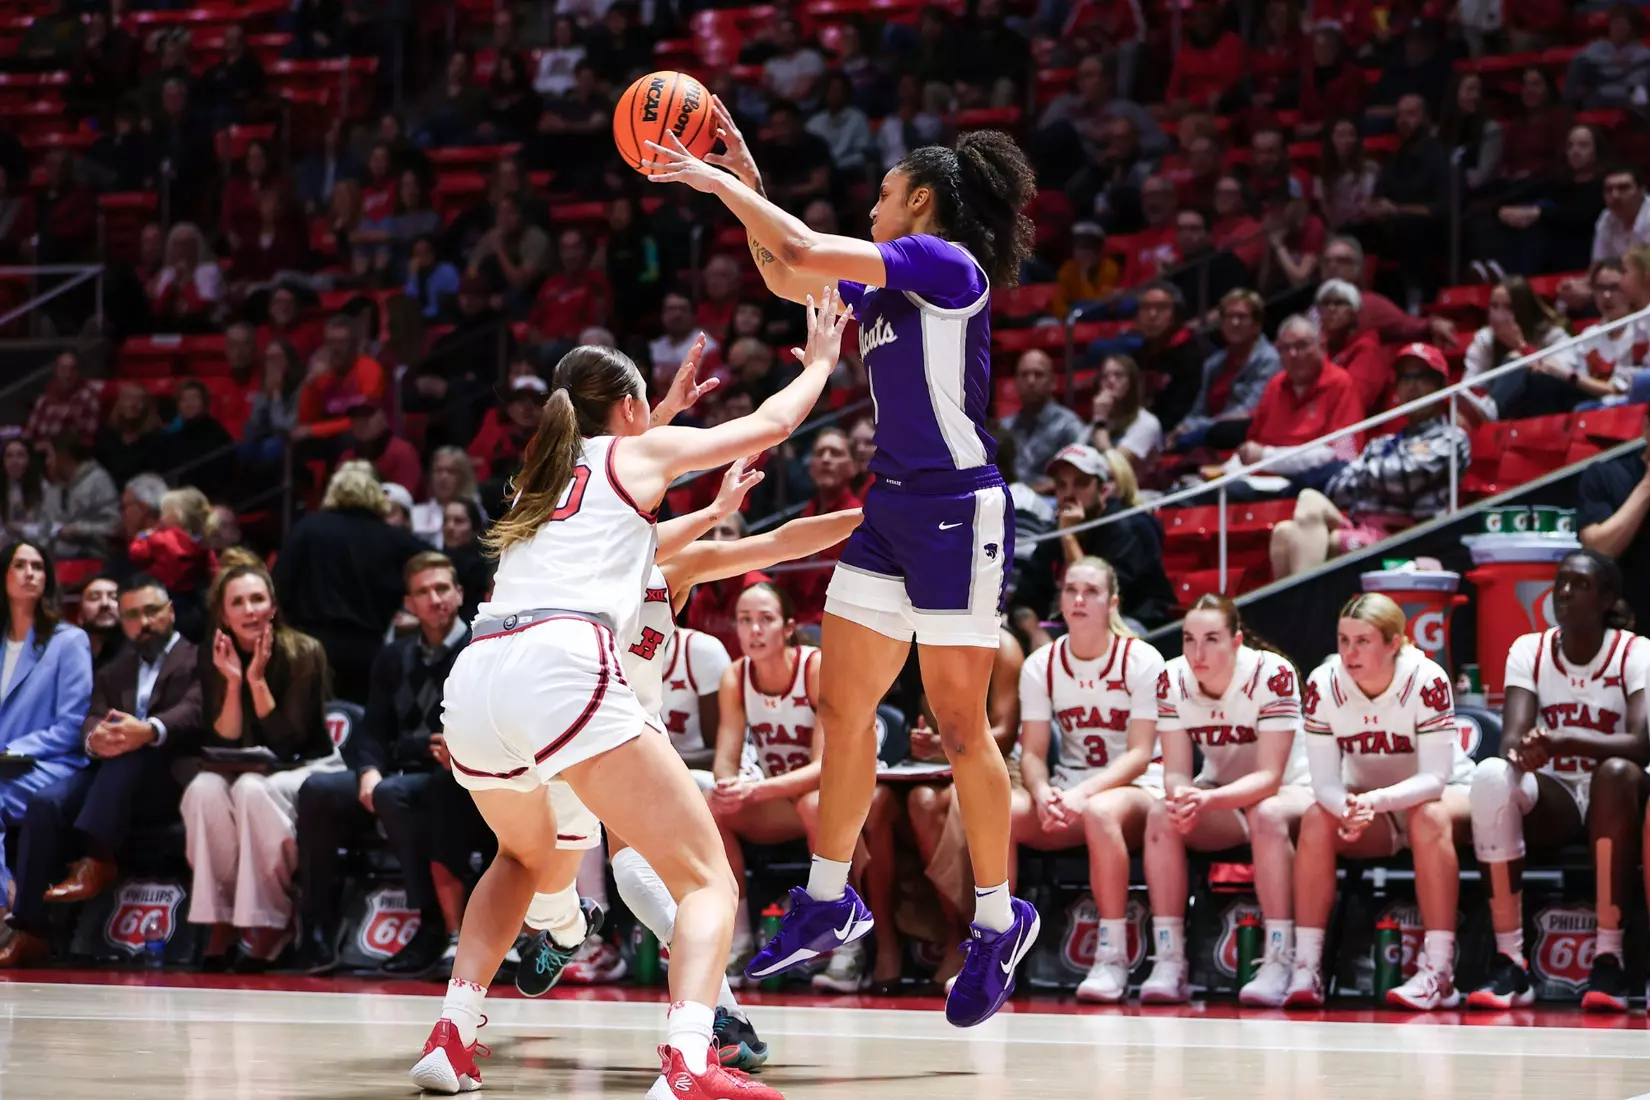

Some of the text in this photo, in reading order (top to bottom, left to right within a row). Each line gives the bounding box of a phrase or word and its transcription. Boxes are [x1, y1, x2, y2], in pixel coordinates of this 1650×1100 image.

[643, 77, 666, 122] NCAA
[672, 79, 701, 137] Wilson
[1413, 612, 1445, 651] G
[1057, 706, 1130, 733] UTAH
[1541, 703, 1621, 735] UTAH
[1083, 735, 1109, 768] 3
[1186, 725, 1258, 747] UTAH
[1337, 731, 1415, 755] UTAH
[124, 889, 174, 903] PHILLIPS
[374, 917, 421, 945] 66
[1549, 937, 1597, 970] 66
